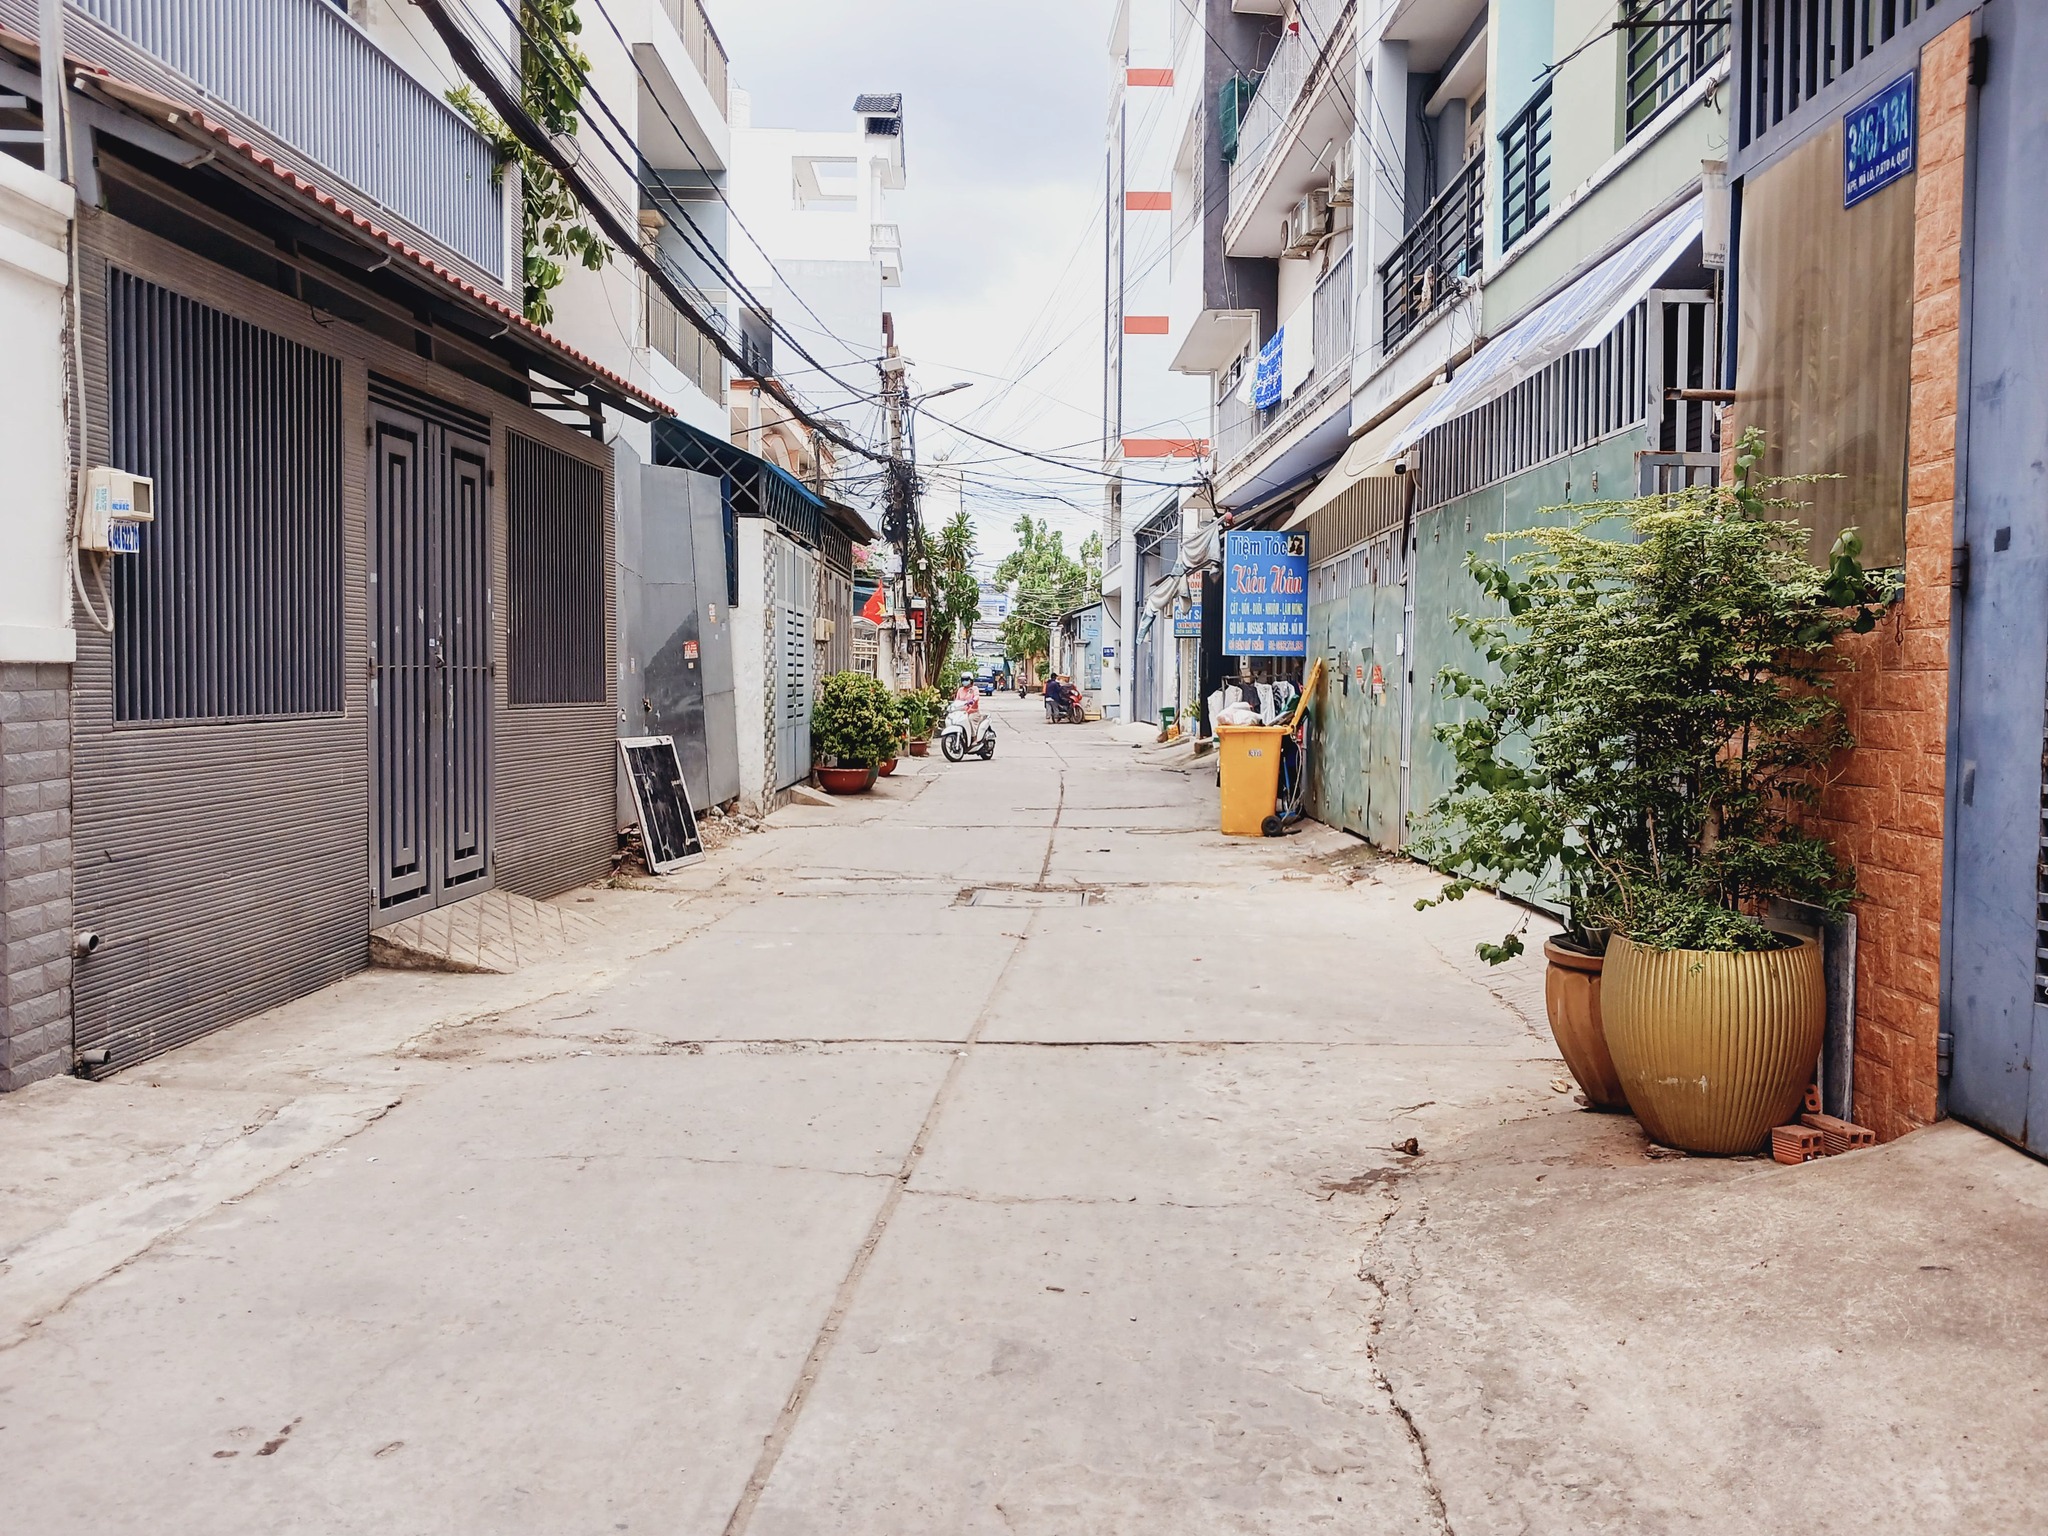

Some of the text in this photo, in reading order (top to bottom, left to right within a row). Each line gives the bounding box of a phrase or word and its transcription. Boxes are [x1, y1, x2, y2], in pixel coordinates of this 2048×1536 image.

[1848, 90, 1909, 173] 346/13A
[1231, 535, 1288, 560] Tiệm Tóc
